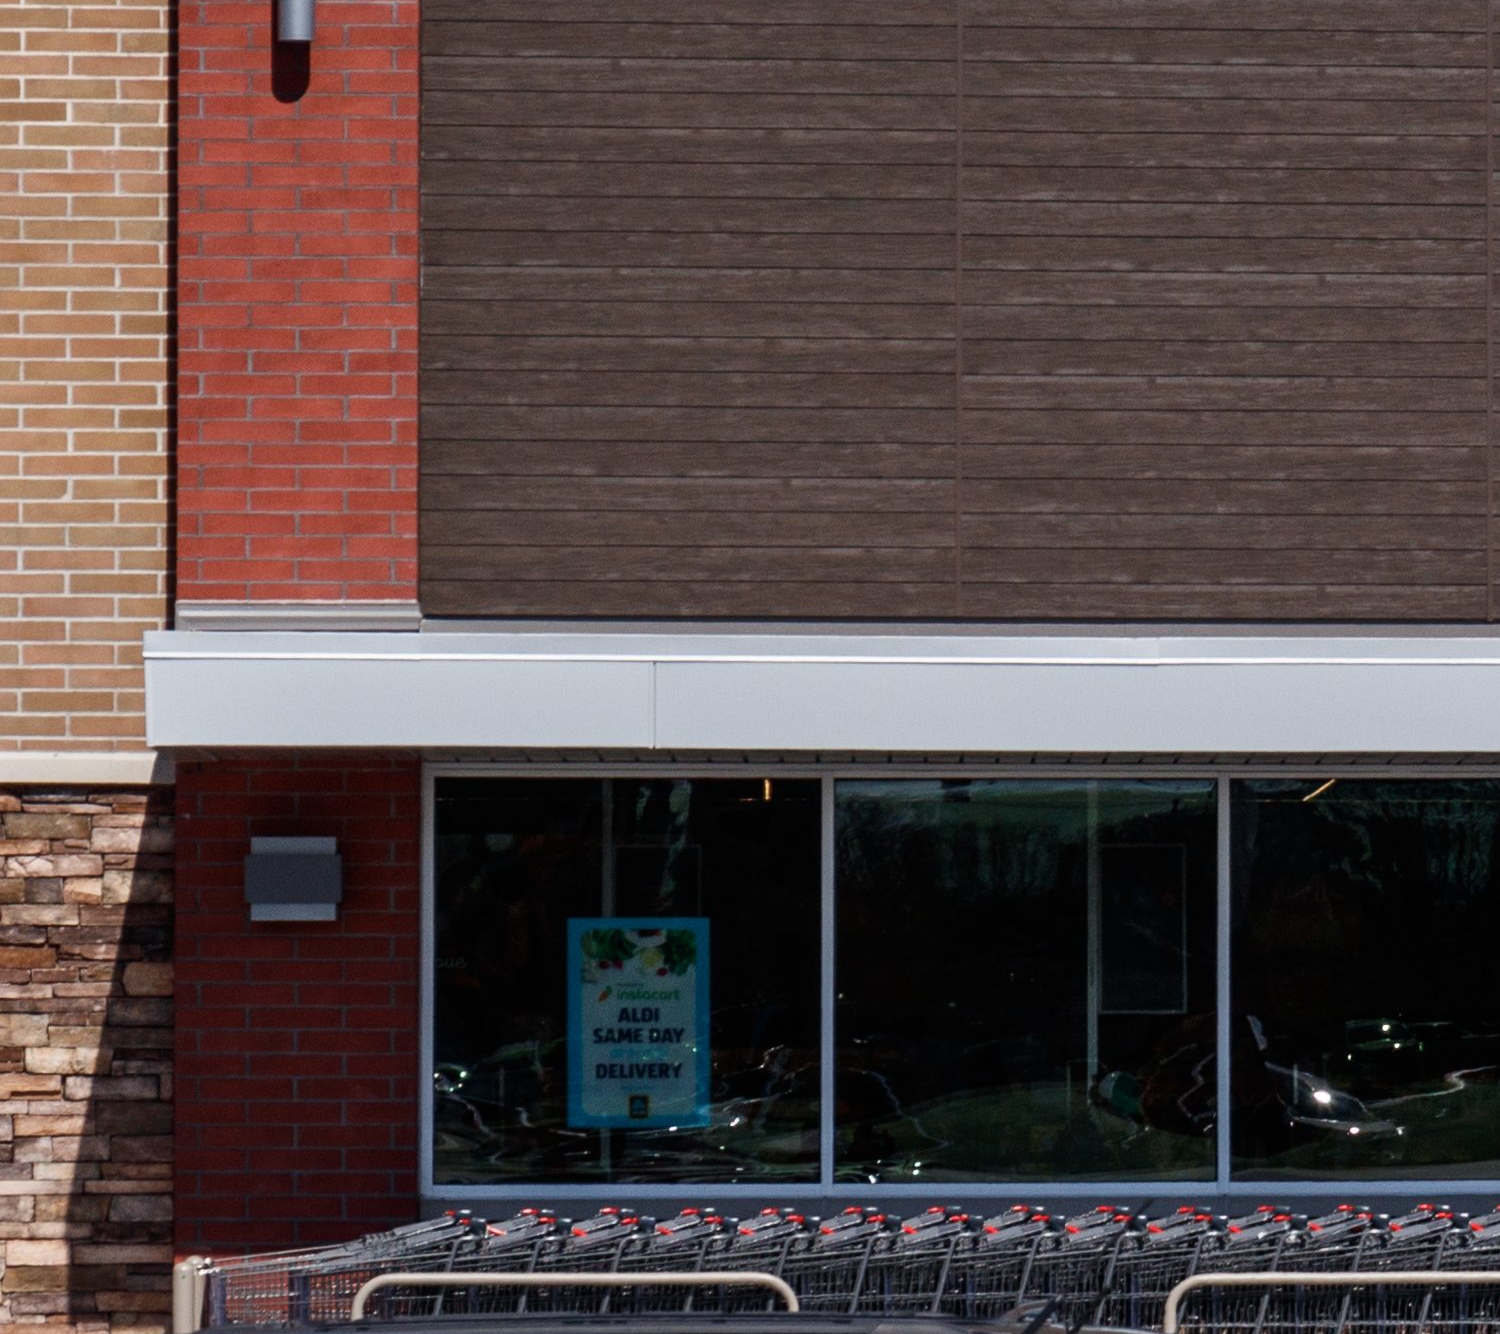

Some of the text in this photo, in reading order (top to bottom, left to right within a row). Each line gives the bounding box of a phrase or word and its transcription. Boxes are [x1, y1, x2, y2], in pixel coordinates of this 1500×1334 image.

[618, 1007, 660, 1023] ALDI
[592, 1028, 685, 1044] SAME DAY
[595, 1063, 683, 1079] DELIVERY
